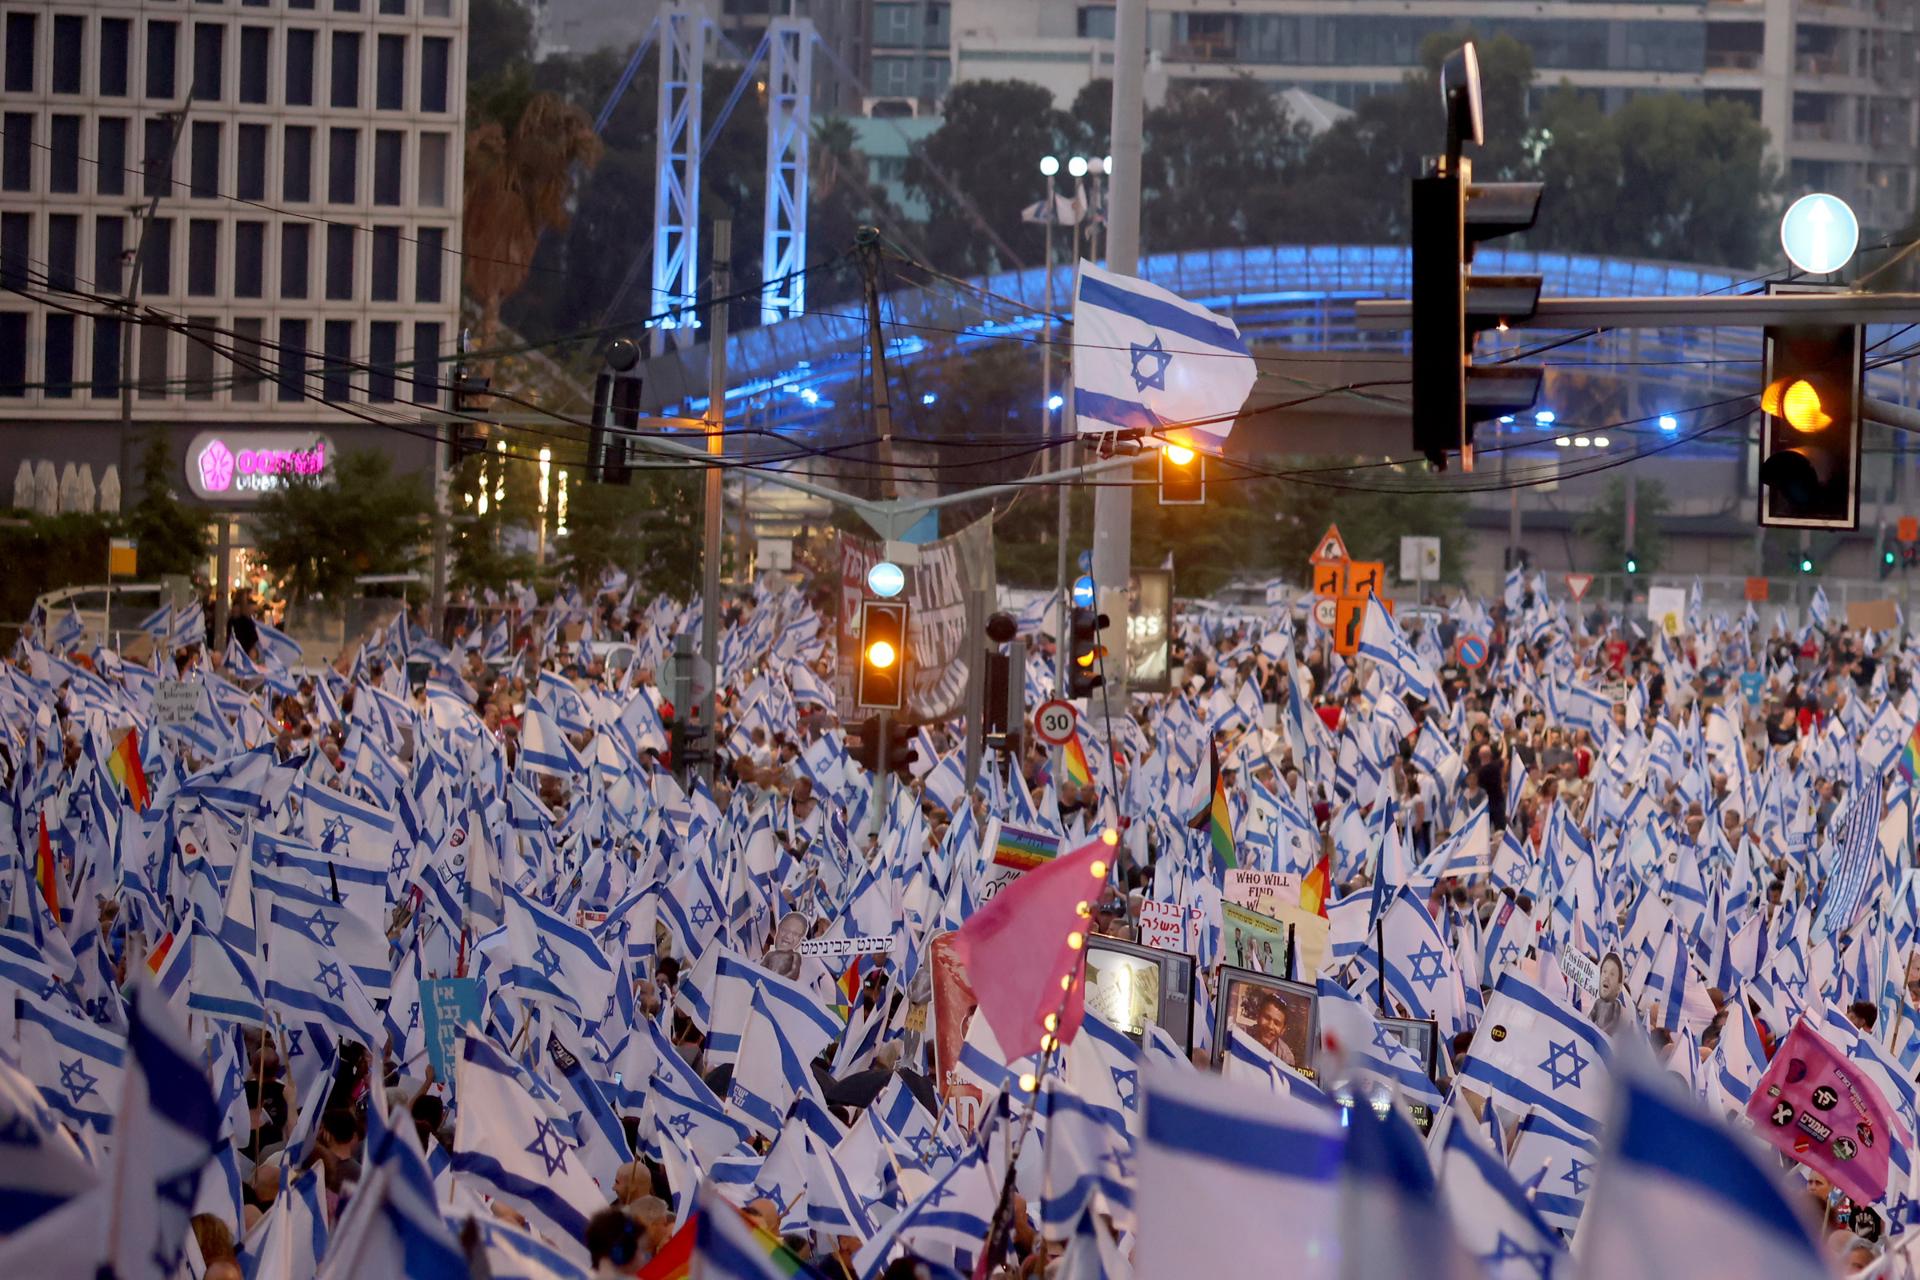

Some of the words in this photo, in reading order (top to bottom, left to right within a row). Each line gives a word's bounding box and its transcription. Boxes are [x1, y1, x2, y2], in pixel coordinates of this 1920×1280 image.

[1045, 714, 1069, 731] 30
[1236, 871, 1261, 884] WHO
[1264, 873, 1290, 887] WILL
[1248, 886, 1274, 897] FIND
[801, 940, 851, 955] קבינימט
[857, 937, 893, 953] קבינט
[1565, 945, 1577, 964] Piss
[1577, 955, 1584, 969] in
[1583, 962, 1594, 978] the
[1563, 959, 1584, 987] Middle
[1583, 977, 1599, 998] East
[1799, 1113, 1830, 1138] נאמנים
